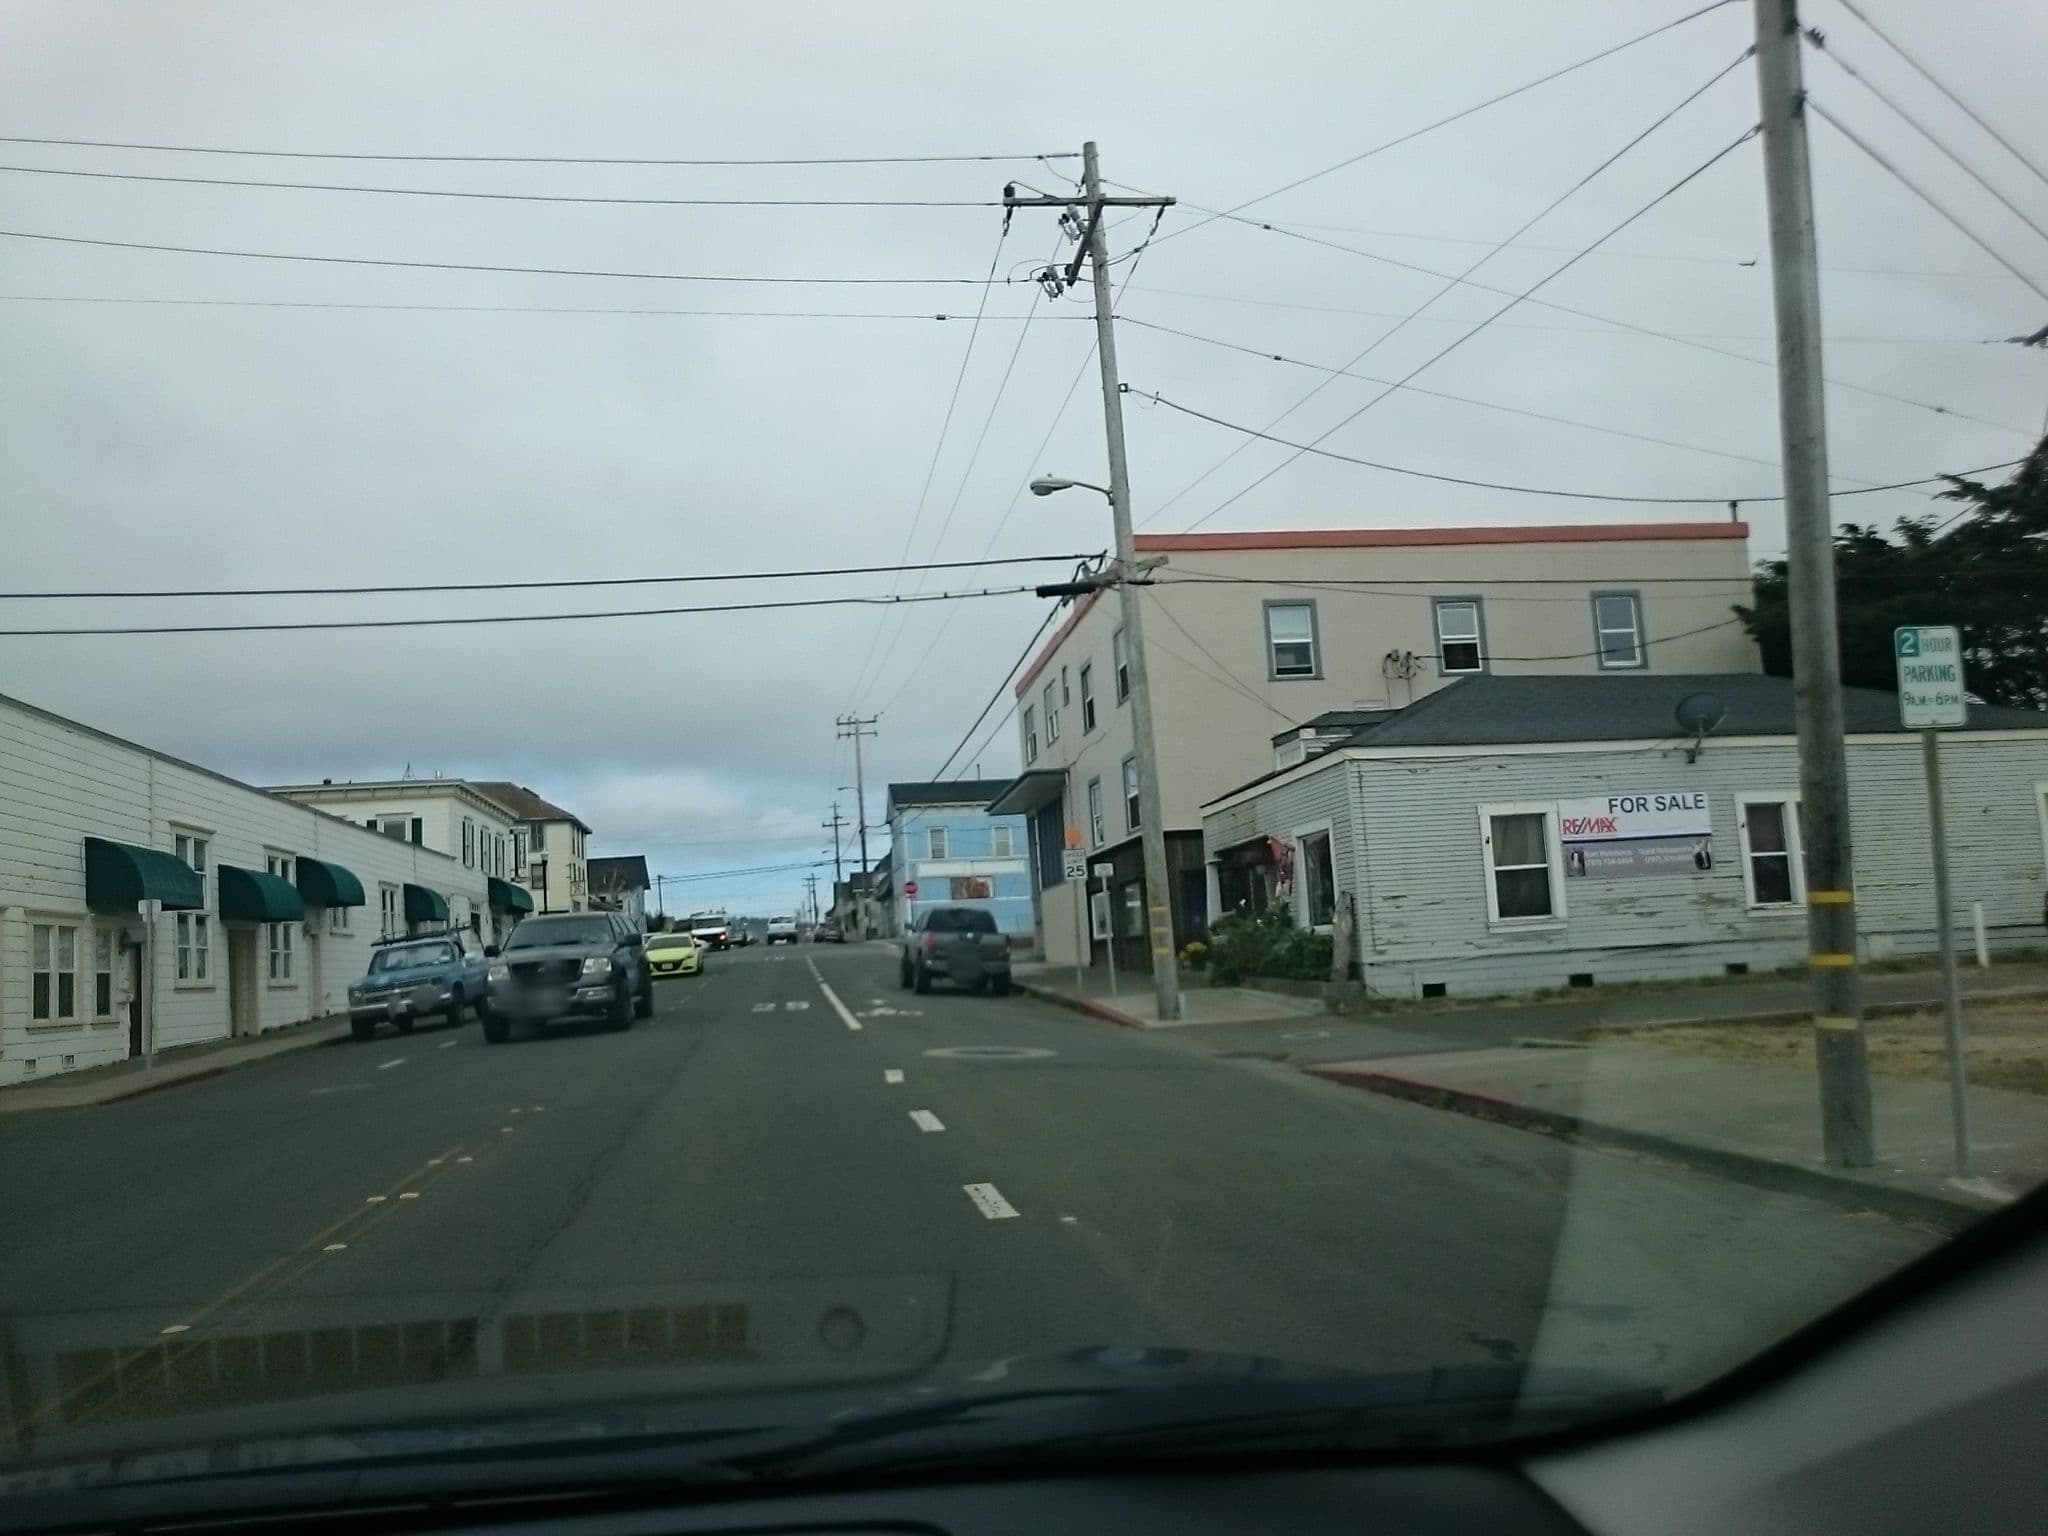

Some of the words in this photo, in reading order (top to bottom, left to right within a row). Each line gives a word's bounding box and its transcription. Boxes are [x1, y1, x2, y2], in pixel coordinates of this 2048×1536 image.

[1901, 632, 1915, 653] 2
[1921, 638, 1952, 652] HOUR
[1904, 664, 1956, 682] PARKING
[1608, 797, 1649, 814] FOR
[1655, 794, 1705, 811] SALE
[1562, 817, 1617, 835] RE/MAX
[1066, 864, 1085, 877] 25
